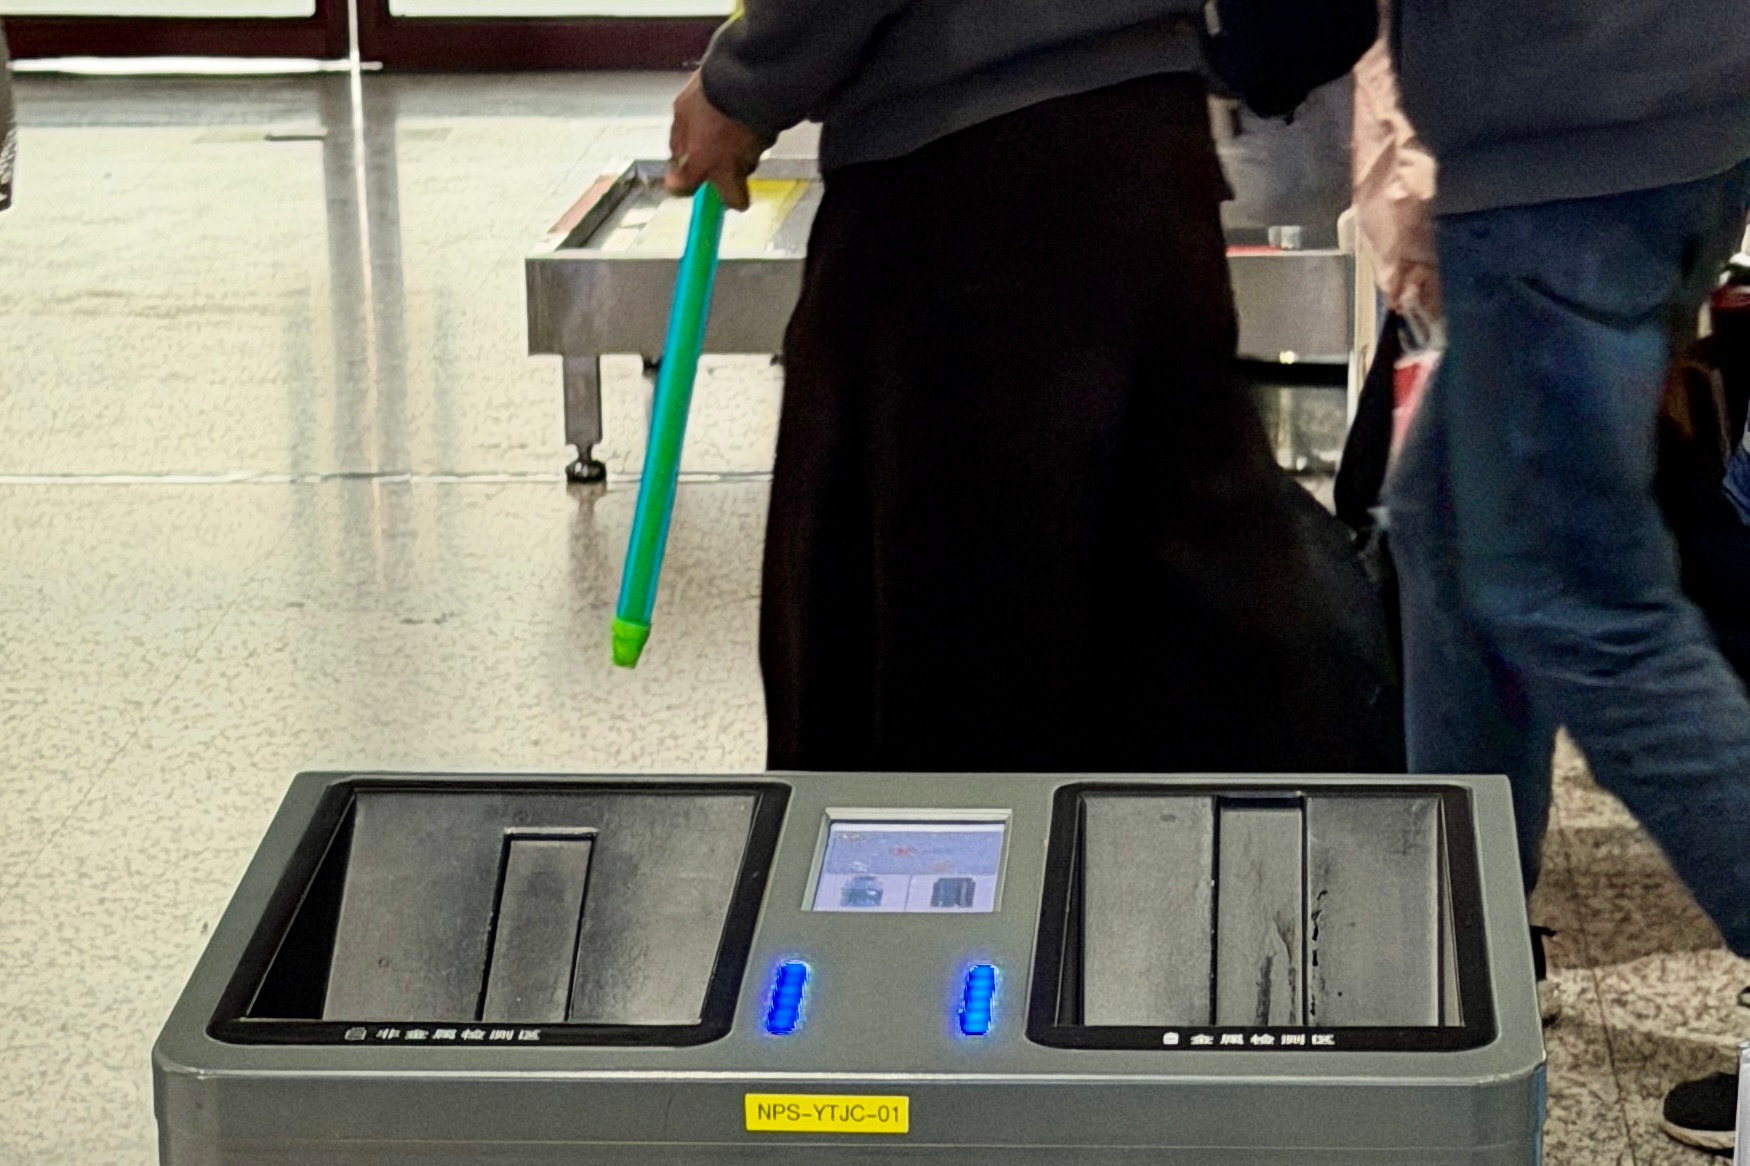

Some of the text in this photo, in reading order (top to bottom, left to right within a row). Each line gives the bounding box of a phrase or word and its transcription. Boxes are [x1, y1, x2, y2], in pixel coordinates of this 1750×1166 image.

[1190, 1032, 1336, 1046] 金属检测区
[757, 1102, 899, 1123] NPS-YTJC-01
